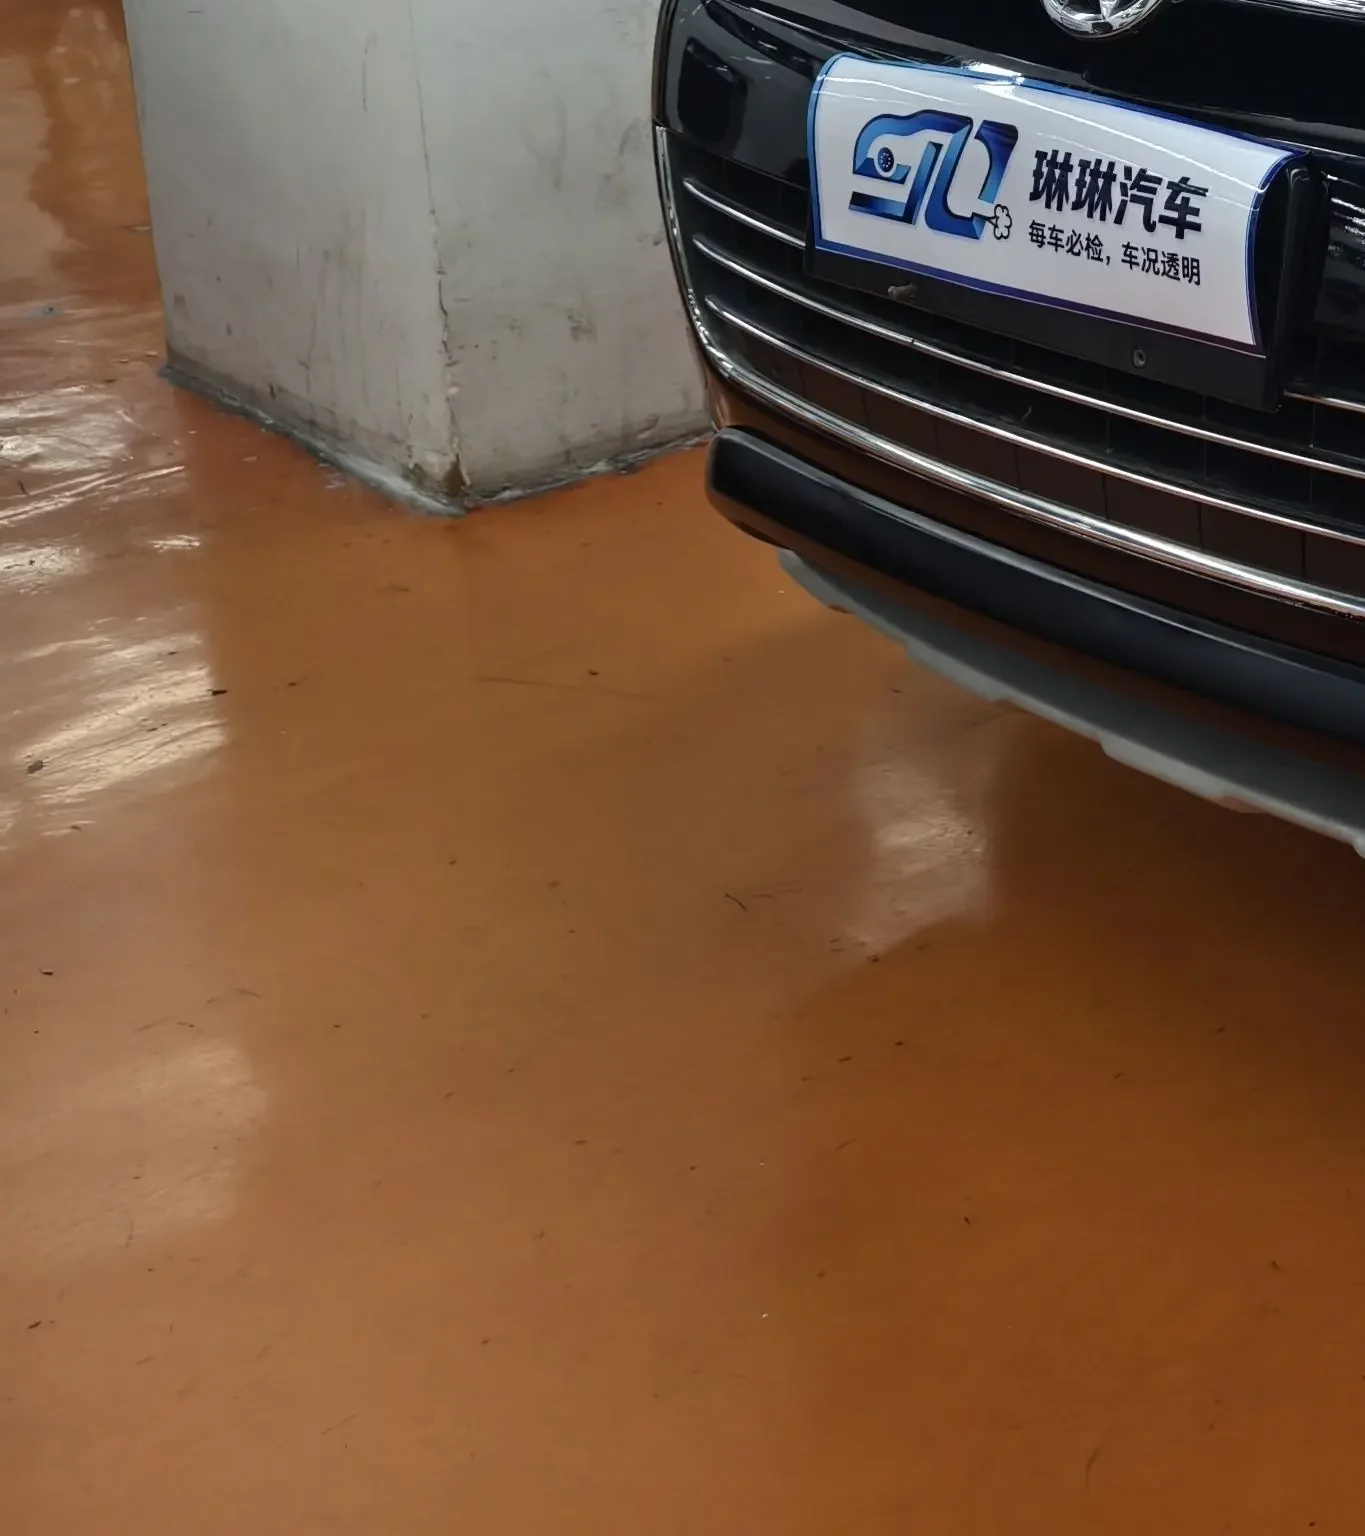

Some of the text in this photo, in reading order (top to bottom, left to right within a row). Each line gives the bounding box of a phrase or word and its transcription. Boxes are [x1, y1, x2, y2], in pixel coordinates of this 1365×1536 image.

[1029, 149, 1209, 240] 琳琳汽车
[1028, 219, 1201, 286] 每车必检，车况透明
